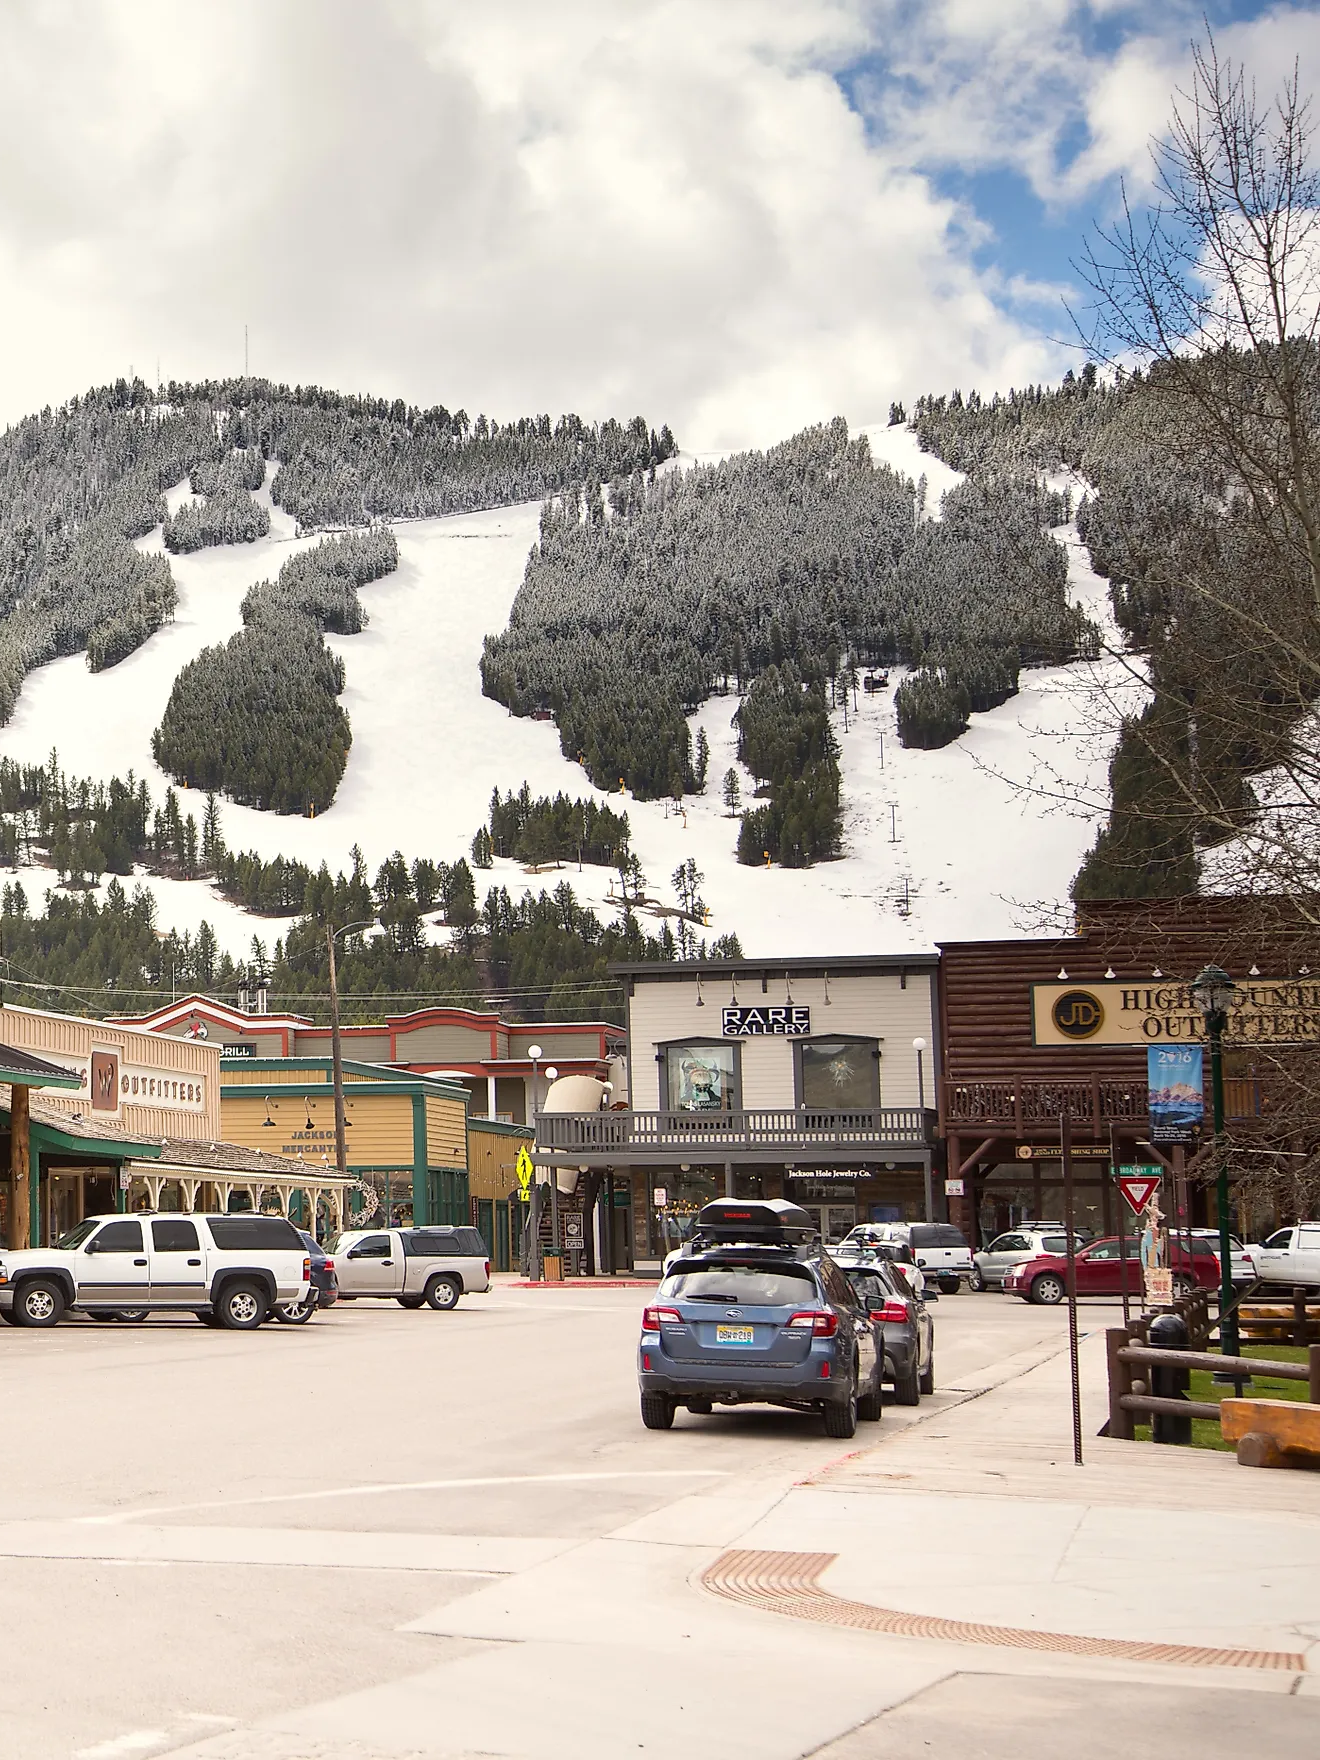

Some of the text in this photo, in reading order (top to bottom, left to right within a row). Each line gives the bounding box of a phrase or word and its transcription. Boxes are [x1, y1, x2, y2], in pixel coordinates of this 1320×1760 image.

[723, 1007, 809, 1025] RARE
[723, 1023, 808, 1035] GALLERY
[121, 1074, 202, 1103] OUTFITTERS
[292, 1131, 337, 1140] JACKSO
[788, 1169, 814, 1178] Jackson
[815, 1169, 832, 1177] Hole
[832, 1169, 858, 1179] Jewelry
